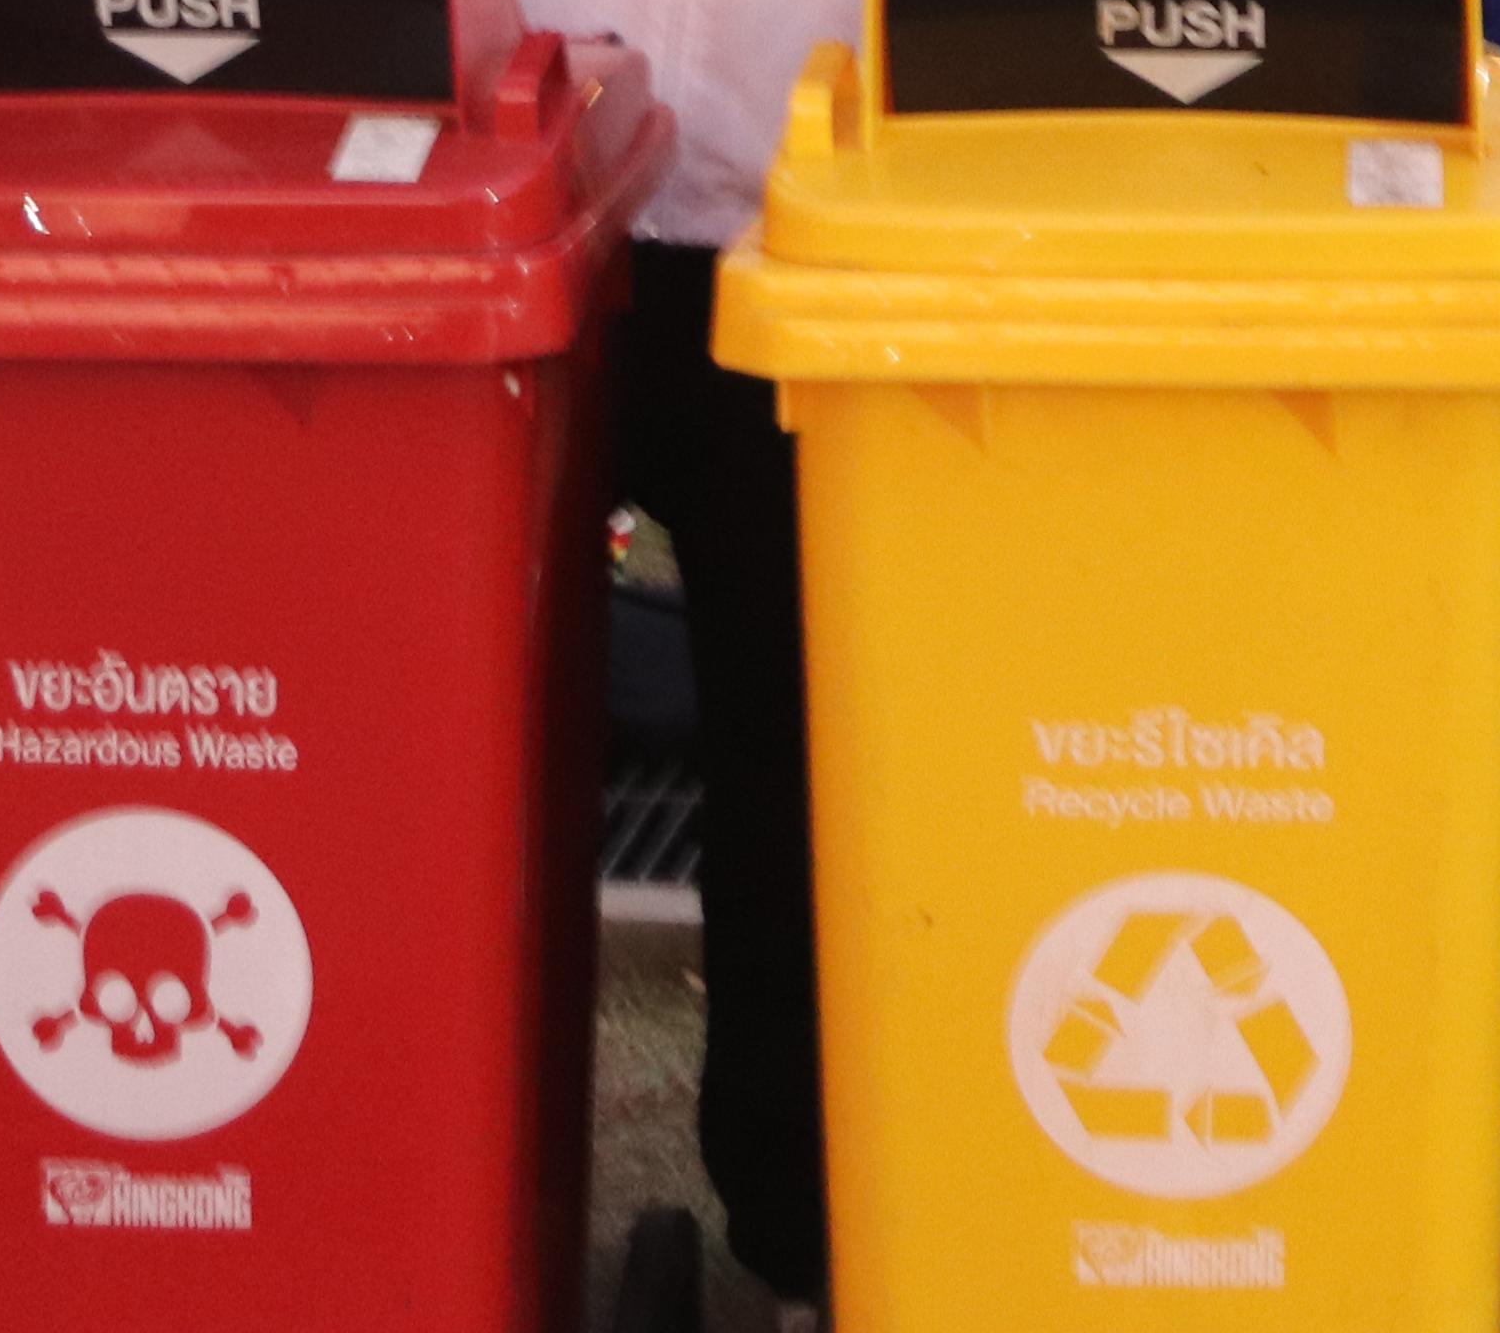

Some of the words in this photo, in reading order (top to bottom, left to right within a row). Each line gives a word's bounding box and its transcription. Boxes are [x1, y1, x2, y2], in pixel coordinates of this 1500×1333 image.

[9, 646, 278, 717] ขยะอันตราย
[191, 724, 298, 771] Waste
[1032, 705, 1328, 771] ขยะรีไซเคิล
[1023, 776, 1192, 827] Recycle
[1203, 783, 1334, 823] Waste
